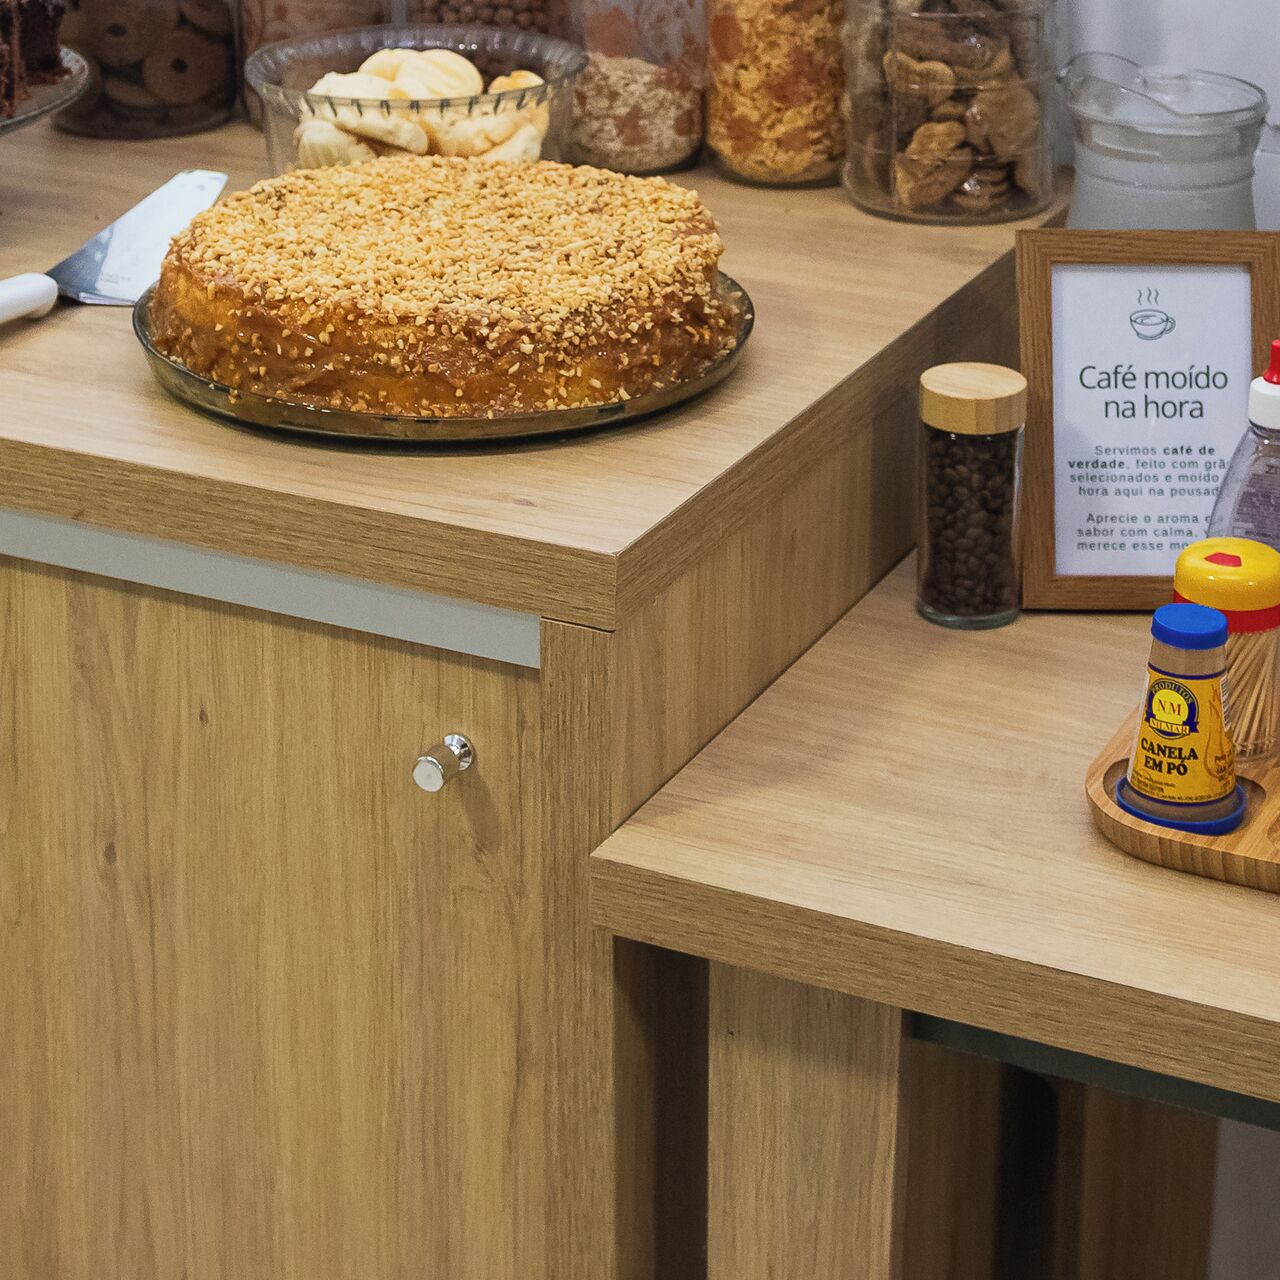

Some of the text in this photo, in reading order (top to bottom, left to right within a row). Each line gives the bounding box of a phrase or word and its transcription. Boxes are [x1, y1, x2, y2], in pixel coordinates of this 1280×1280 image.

[1079, 364, 1228, 389] Café moído
[1104, 394, 1204, 419] na hora
[1094, 445, 1216, 456] Servimos café de
[1136, 459, 1166, 470] feito
[1171, 461, 1199, 470] com
[1070, 472, 1220, 484] selecionados e moído
[1078, 486, 1109, 497] hora
[1114, 486, 1143, 499] aqui
[1148, 488, 1165, 497] na
[1086, 513, 1138, 525] Aprecie
[1143, 515, 1152, 524] o
[1157, 515, 1199, 524] aroma
[1076, 527, 1114, 538] sabor
[1120, 528, 1148, 538] com
[1076, 541, 1127, 551] merece
[1132, 541, 1164, 551] esse
[1151, 681, 1194, 704] PRODUTOS
[1140, 737, 1199, 761] CANELA
[1144, 755, 1188, 776] EM PÓ
